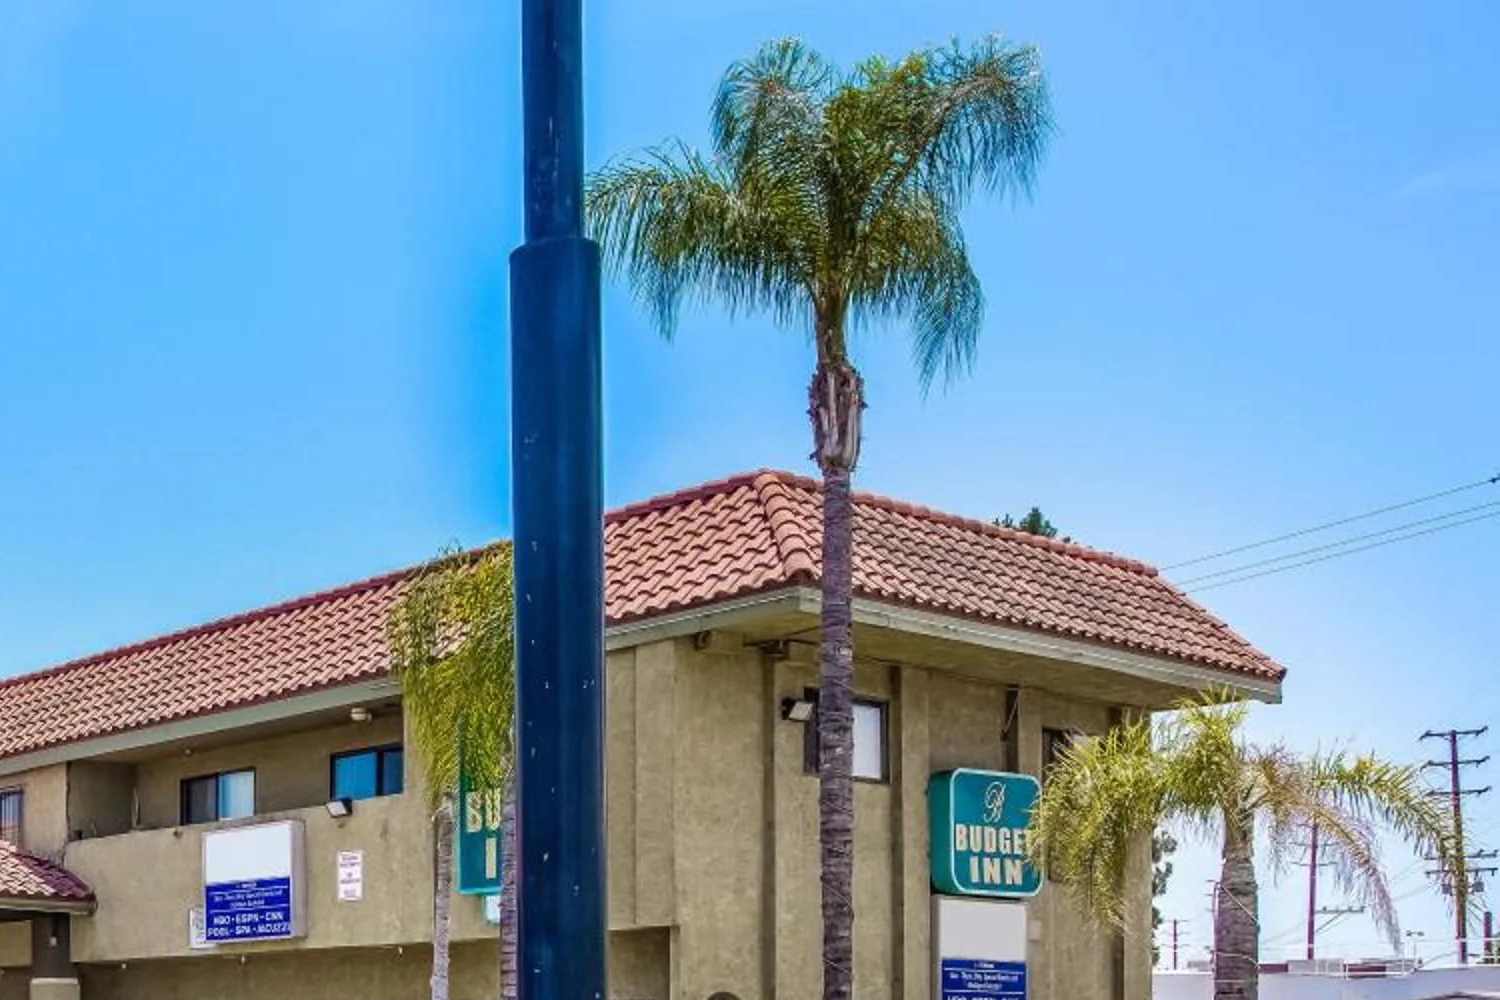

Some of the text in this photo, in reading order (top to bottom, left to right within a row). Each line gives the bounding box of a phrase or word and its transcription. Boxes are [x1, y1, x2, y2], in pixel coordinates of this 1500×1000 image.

[969, 855, 1023, 885] INN
[213, 915, 231, 925] HBO
[235, 913, 259, 924] ESPN
[207, 927, 229, 937] POOL
[235, 925, 251, 935] SPA
